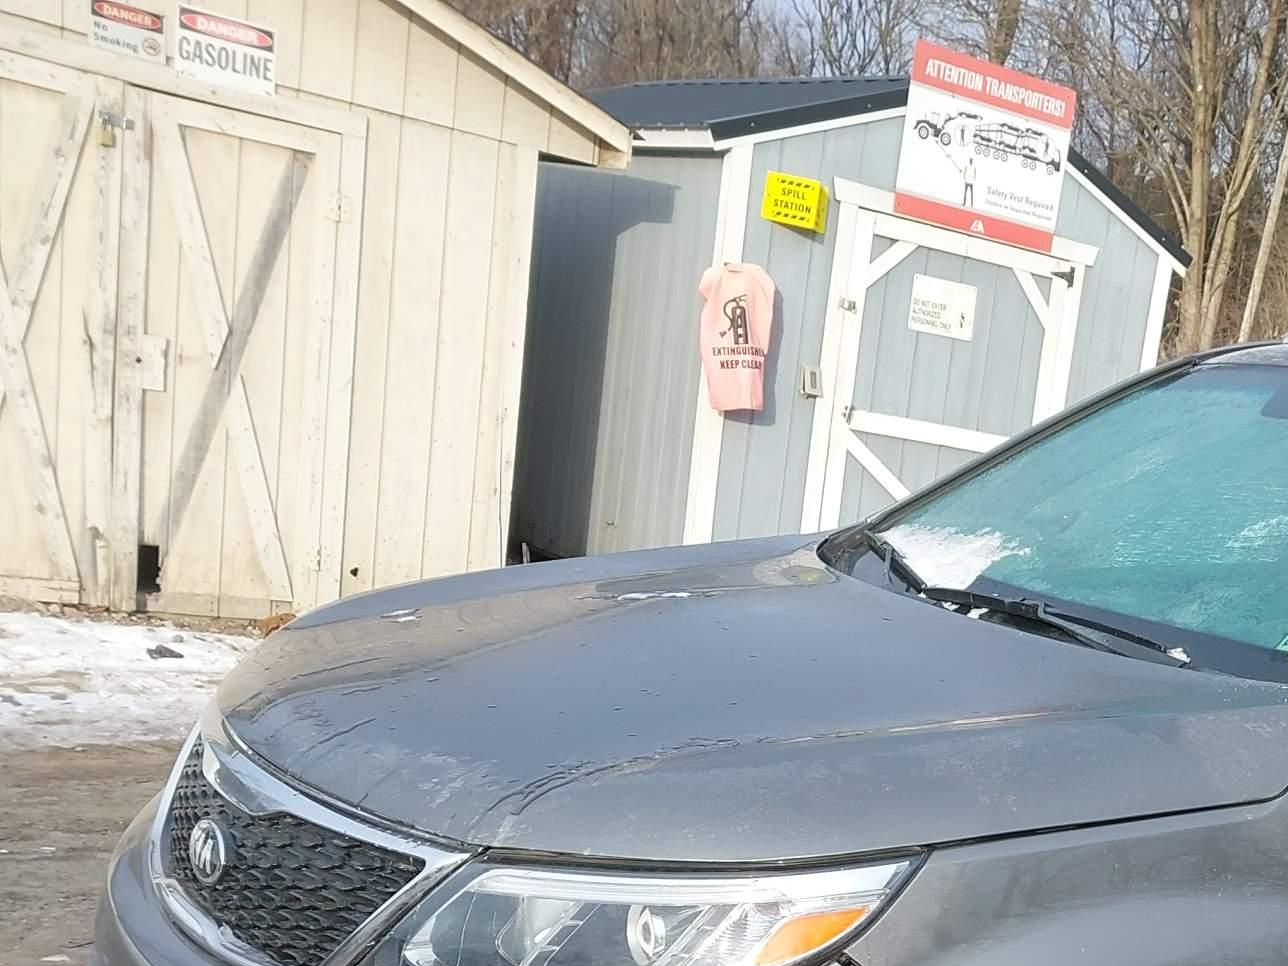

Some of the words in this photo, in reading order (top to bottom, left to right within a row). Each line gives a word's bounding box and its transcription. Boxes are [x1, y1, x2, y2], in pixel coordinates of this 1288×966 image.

[93, 20, 109, 33] No
[103, 4, 152, 28] DANGER
[93, 31, 140, 55] Smoking
[196, 16, 259, 47] DANGER
[178, 35, 274, 83] GASOLINE
[925, 58, 984, 92] ATTENTION
[985, 76, 1067, 119] TRANSPORTERS!
[781, 187, 807, 201] SPILL
[773, 198, 812, 215] STATION
[720, 360, 740, 370] KEEP
